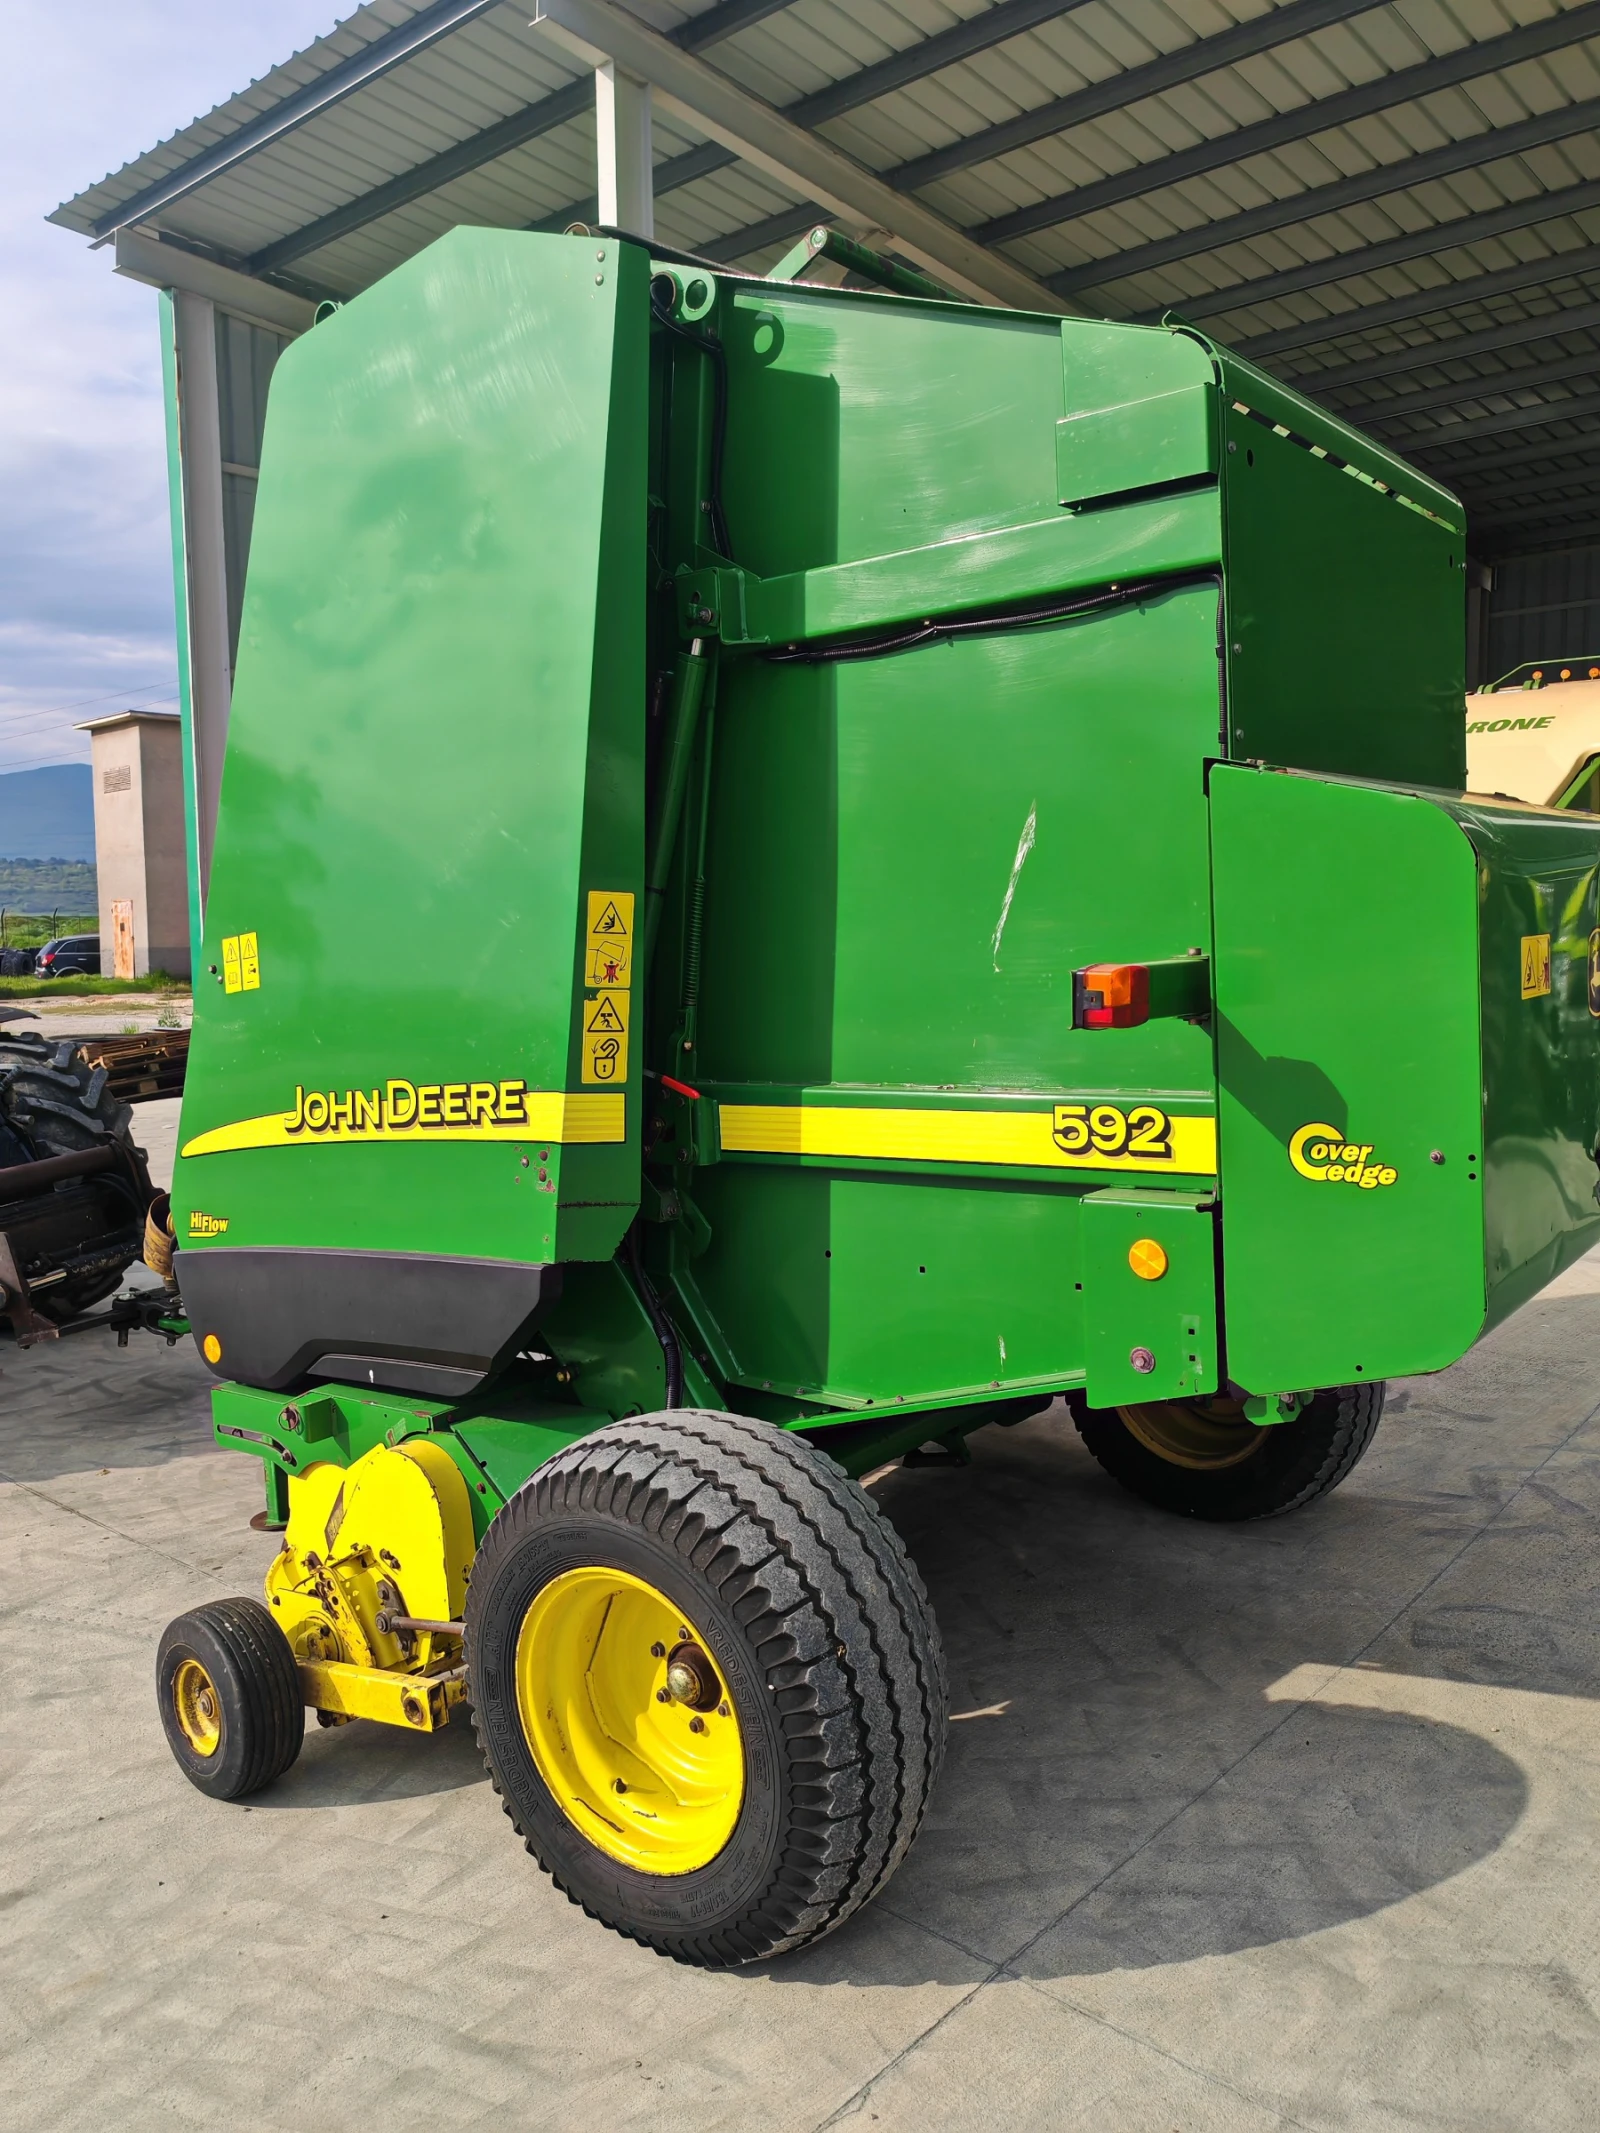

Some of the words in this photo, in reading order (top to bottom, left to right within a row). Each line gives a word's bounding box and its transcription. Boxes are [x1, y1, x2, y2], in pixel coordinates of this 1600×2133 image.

[1466, 716, 1556, 734] RONE
[284, 1084, 385, 1133] JOHN
[386, 1078, 529, 1130] DEERE
[1052, 1104, 1173, 1161] 592
[1288, 1121, 1375, 1181] Cover
[1325, 1161, 1399, 1190] edge
[190, 1210, 229, 1233] HiFlow
[703, 1616, 765, 1746] VREDESTEIN
[488, 1700, 539, 1818] VREDESTEIN
